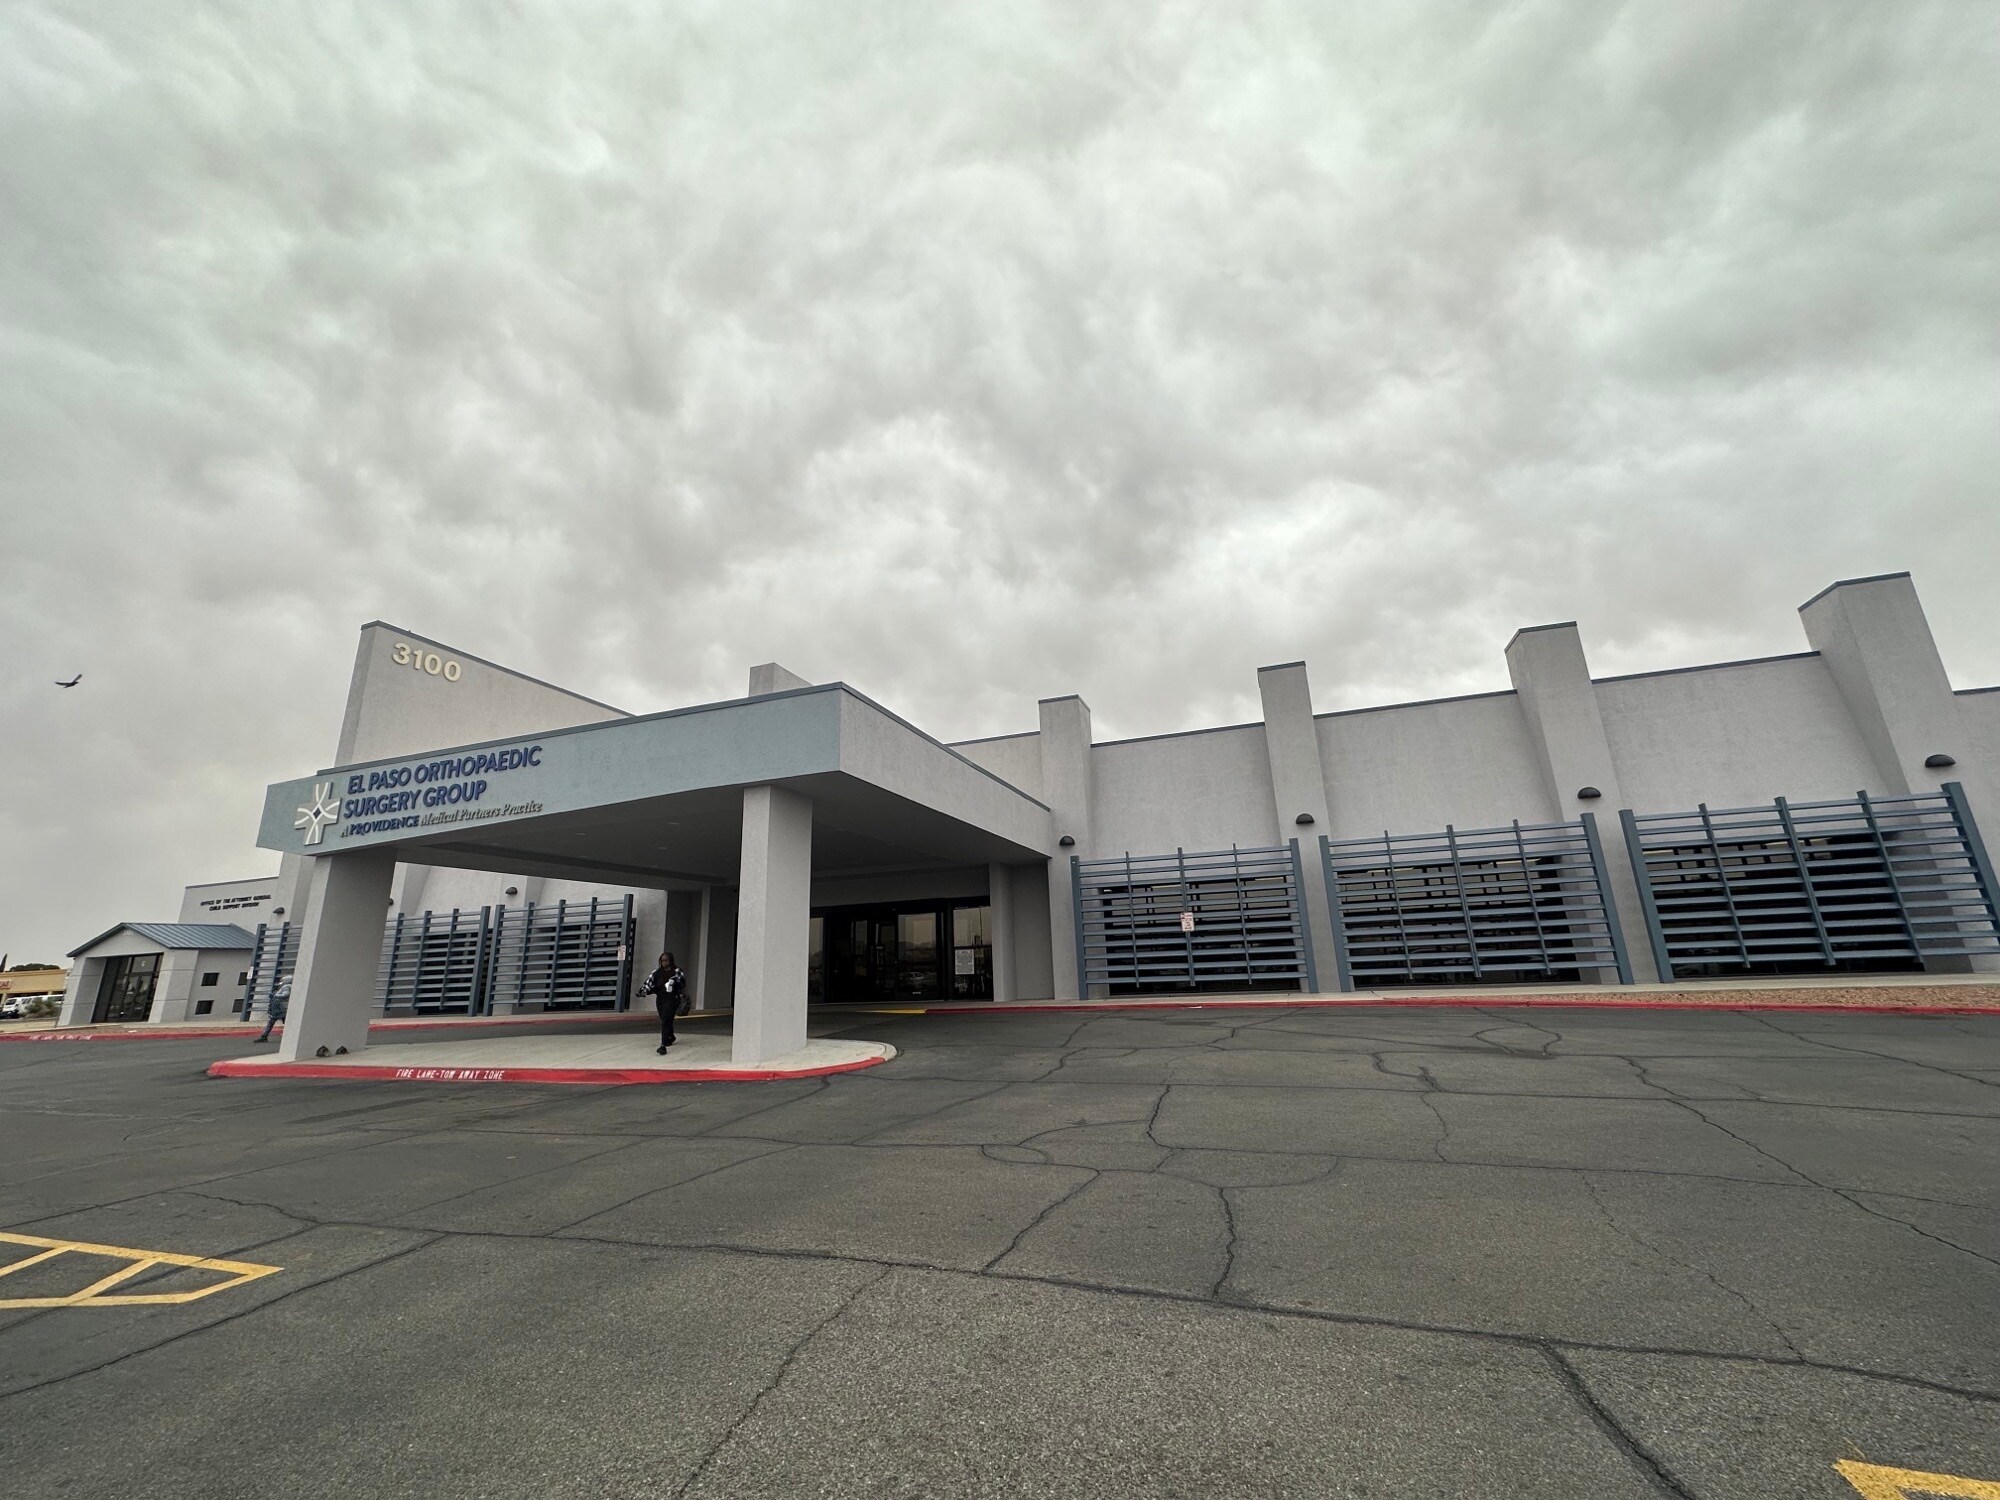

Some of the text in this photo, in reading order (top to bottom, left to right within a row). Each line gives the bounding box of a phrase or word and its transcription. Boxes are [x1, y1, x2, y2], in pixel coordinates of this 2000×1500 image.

[392, 642, 462, 682] 3100
[347, 745, 542, 794] EL PASO ORTHOPAEDIC
[343, 779, 487, 819] SURGERY GROUP
[349, 814, 420, 836] PROVIDENCE
[420, 810, 459, 826] Medical
[459, 808, 501, 822] Partners
[501, 800, 543, 817] Practice
[396, 1068, 414, 1078] FIRE
[458, 1070, 480, 1079] AWAY
[483, 1070, 505, 1080] ZONE
